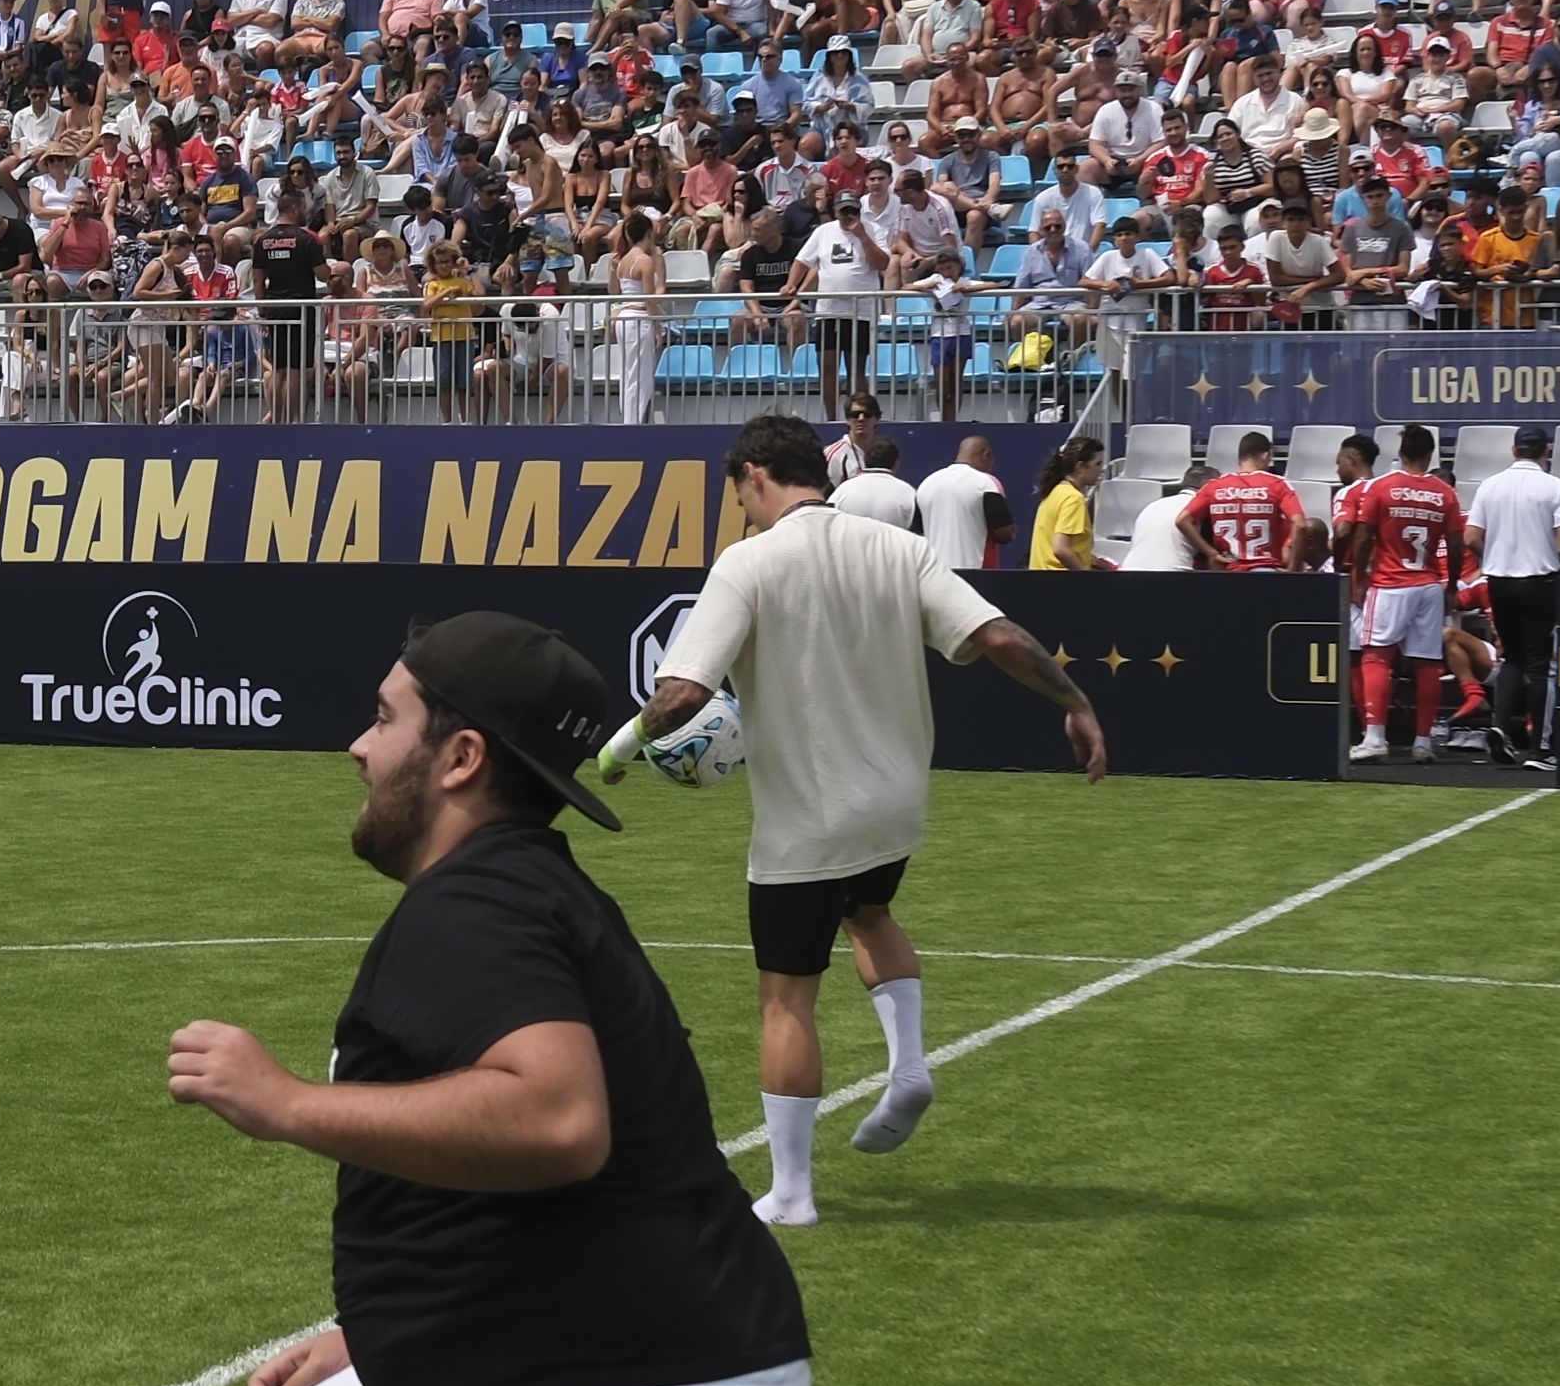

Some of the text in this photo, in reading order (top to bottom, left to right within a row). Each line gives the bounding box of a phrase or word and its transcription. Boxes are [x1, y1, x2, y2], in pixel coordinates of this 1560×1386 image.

[1412, 365, 1480, 404] LIGA
[244, 458, 382, 564] NA
[420, 459, 760, 567] NAZA
[1213, 518, 1272, 561] 32
[1401, 525, 1429, 571] 3
[21, 673, 283, 727] TrueClinic
